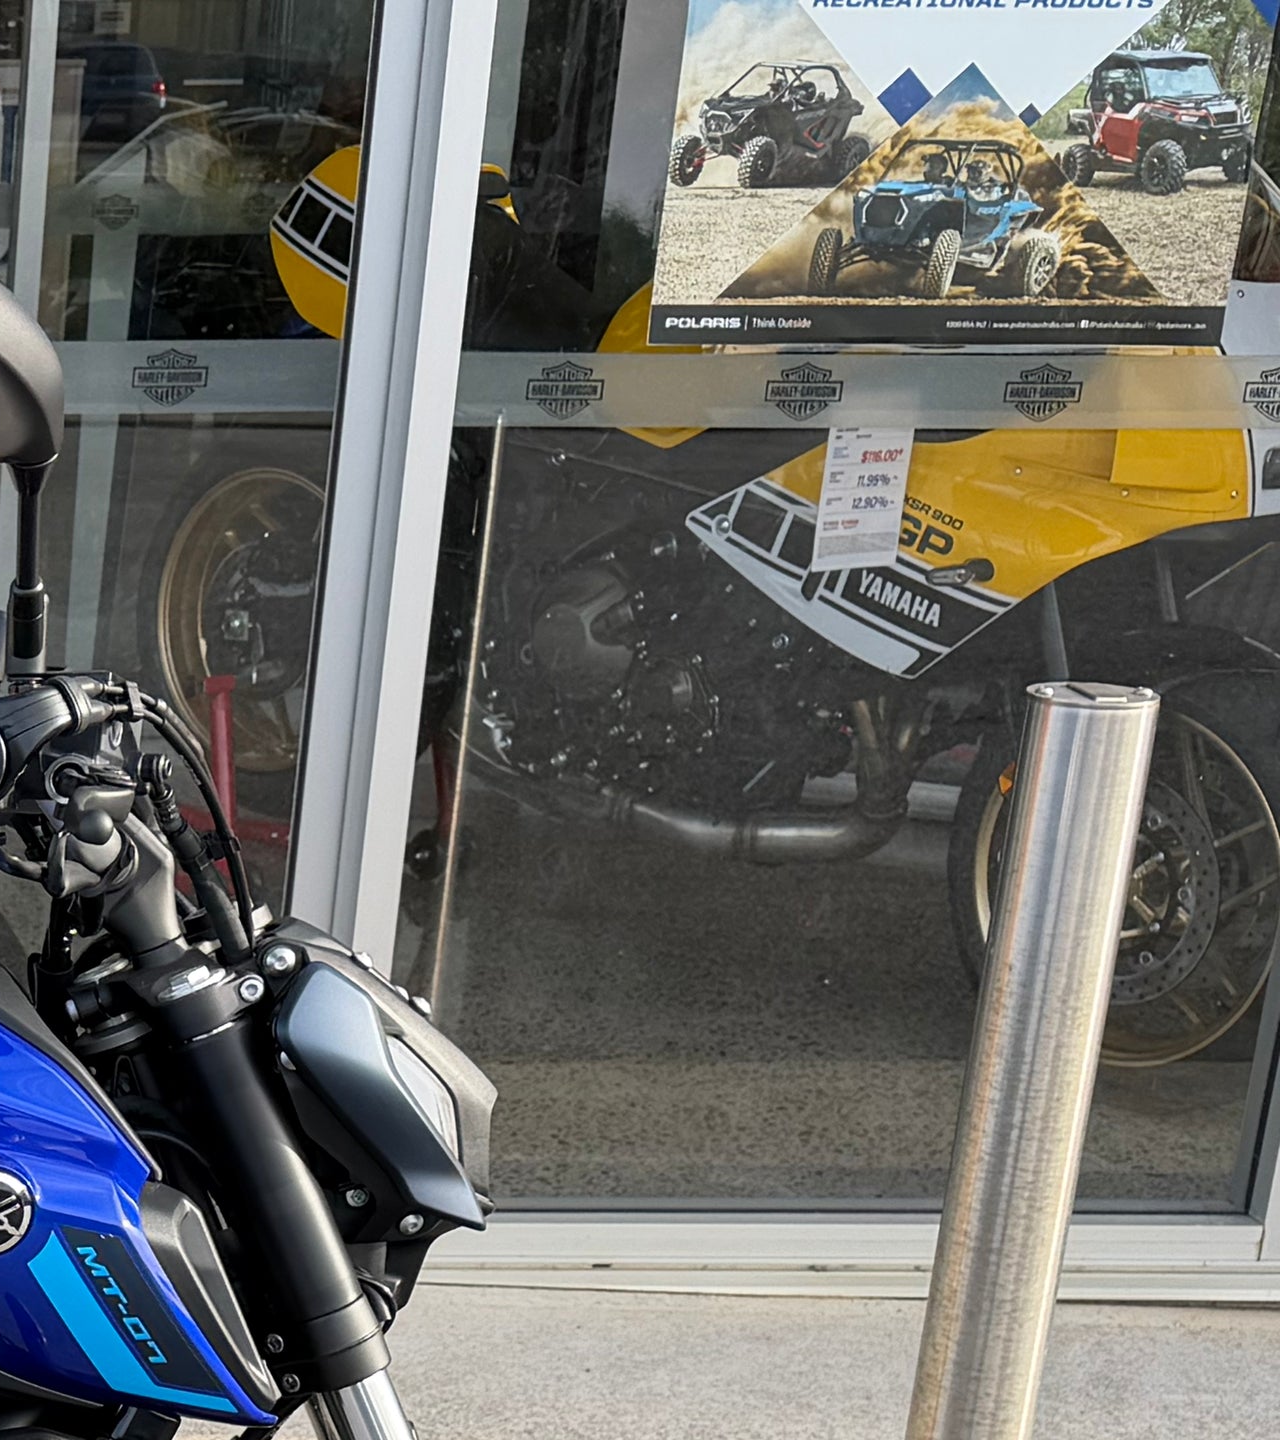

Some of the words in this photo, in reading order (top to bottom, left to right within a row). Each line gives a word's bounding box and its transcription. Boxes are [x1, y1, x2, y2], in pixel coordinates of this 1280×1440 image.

[665, 317, 740, 329] POLARIS
[899, 511, 954, 555] GP
[931, 509, 964, 531] 900
[859, 569, 941, 628] YAMAHA
[76, 1245, 167, 1365] MT-07
